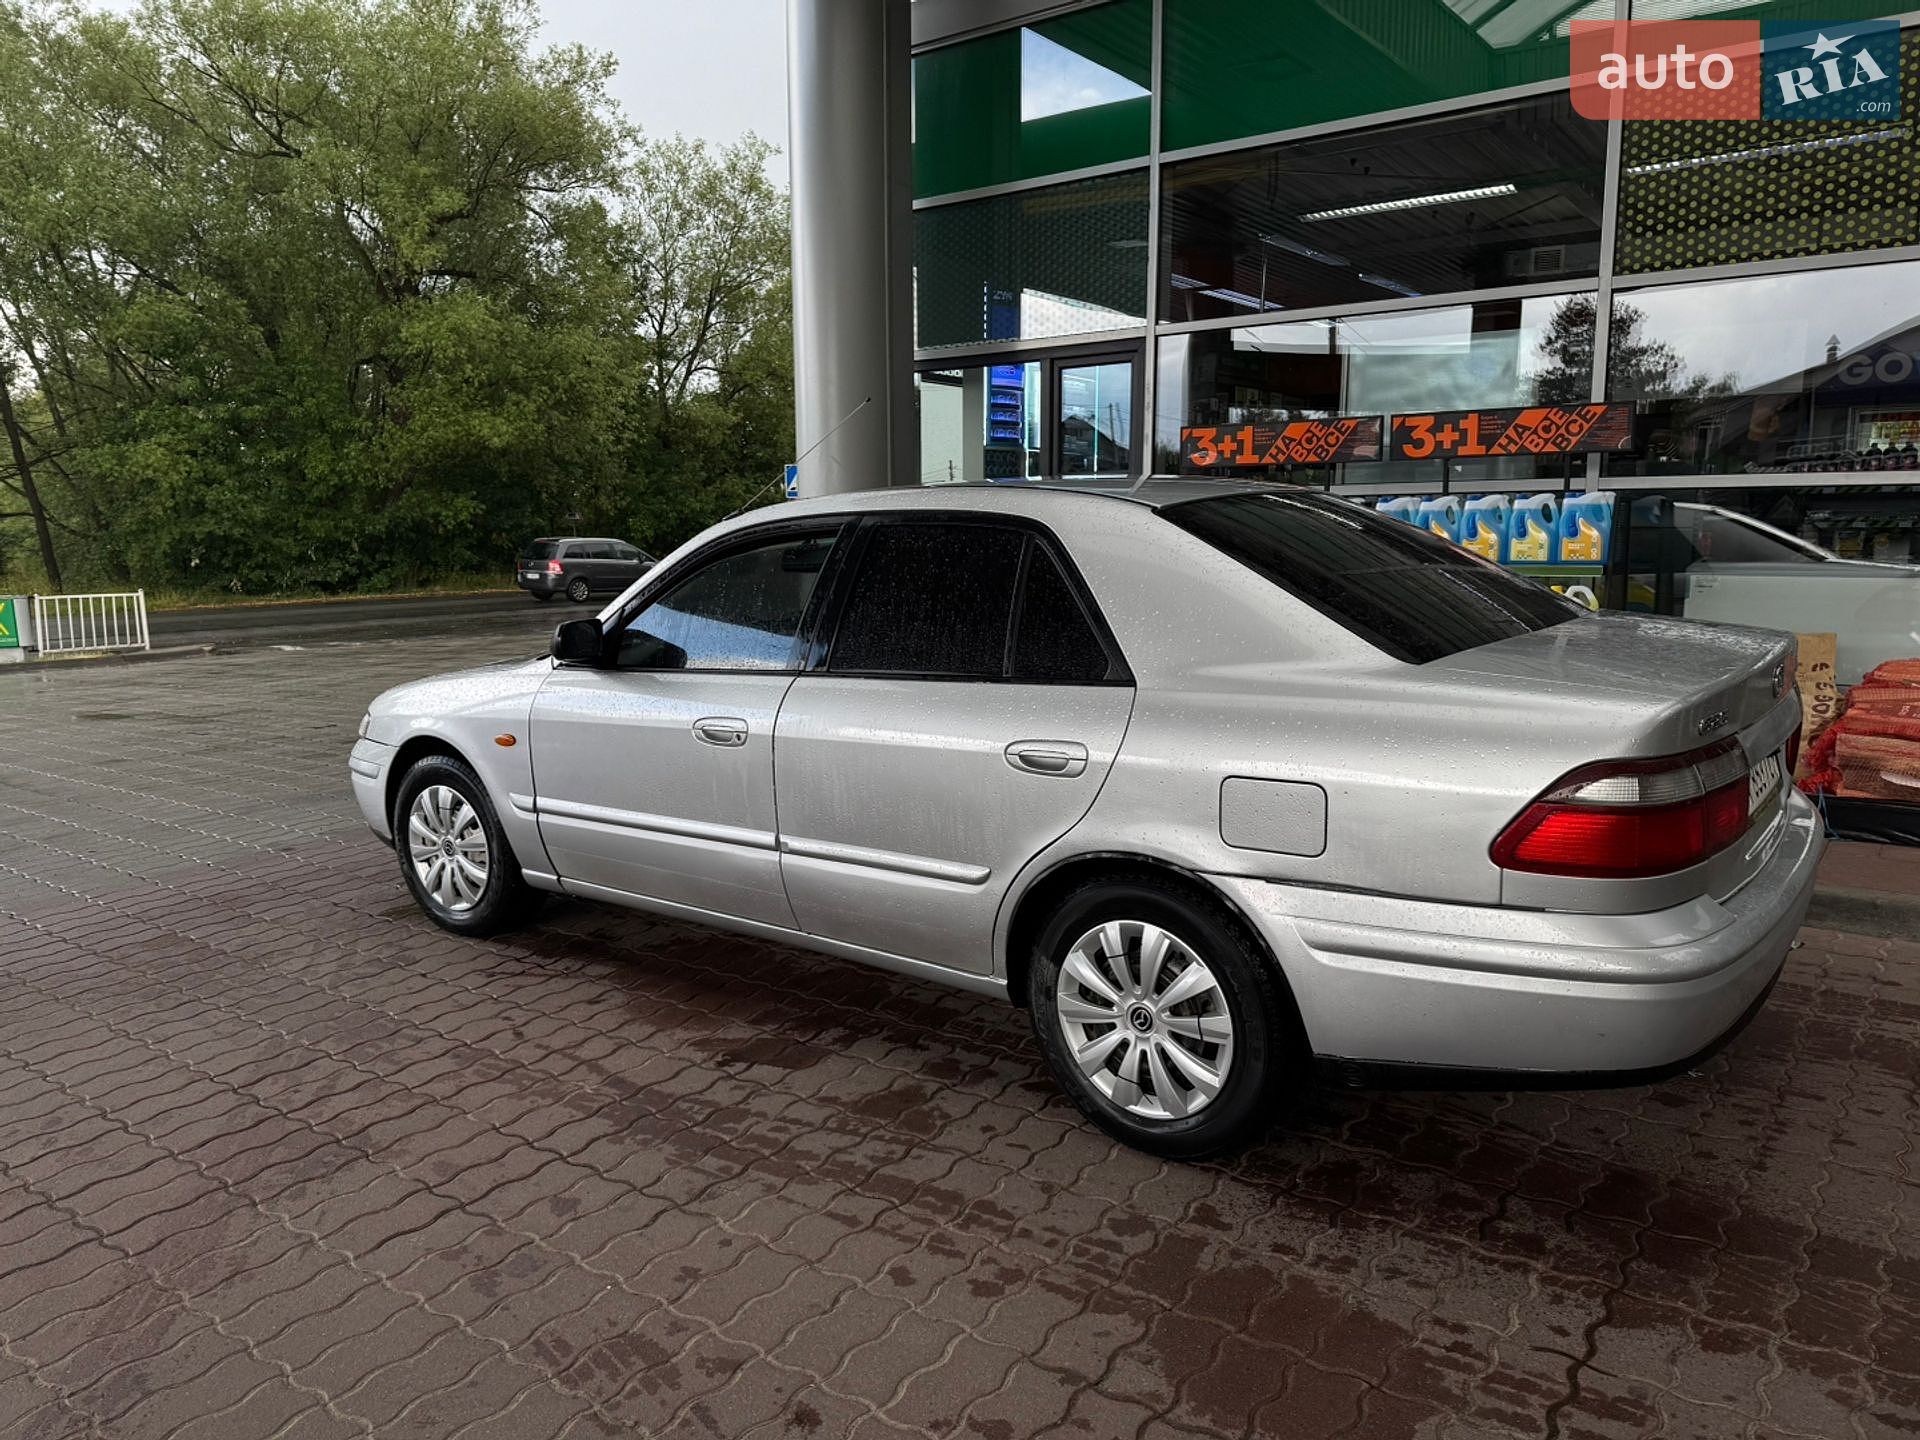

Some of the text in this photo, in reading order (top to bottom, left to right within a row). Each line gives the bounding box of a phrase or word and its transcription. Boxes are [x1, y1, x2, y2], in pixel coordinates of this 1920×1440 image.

[1839, 352, 1919, 385] GO
[1190, 425, 1260, 466] 3+1
[1271, 434, 1297, 462] НА
[1292, 421, 1328, 462] ВСЕ
[1312, 421, 1352, 461] ВСЕ
[1402, 413, 1486, 458] 3+1
[1499, 422, 1533, 454] НА
[1523, 407, 1569, 453] ВСЕ
[1552, 406, 1597, 450] ВСЕ
